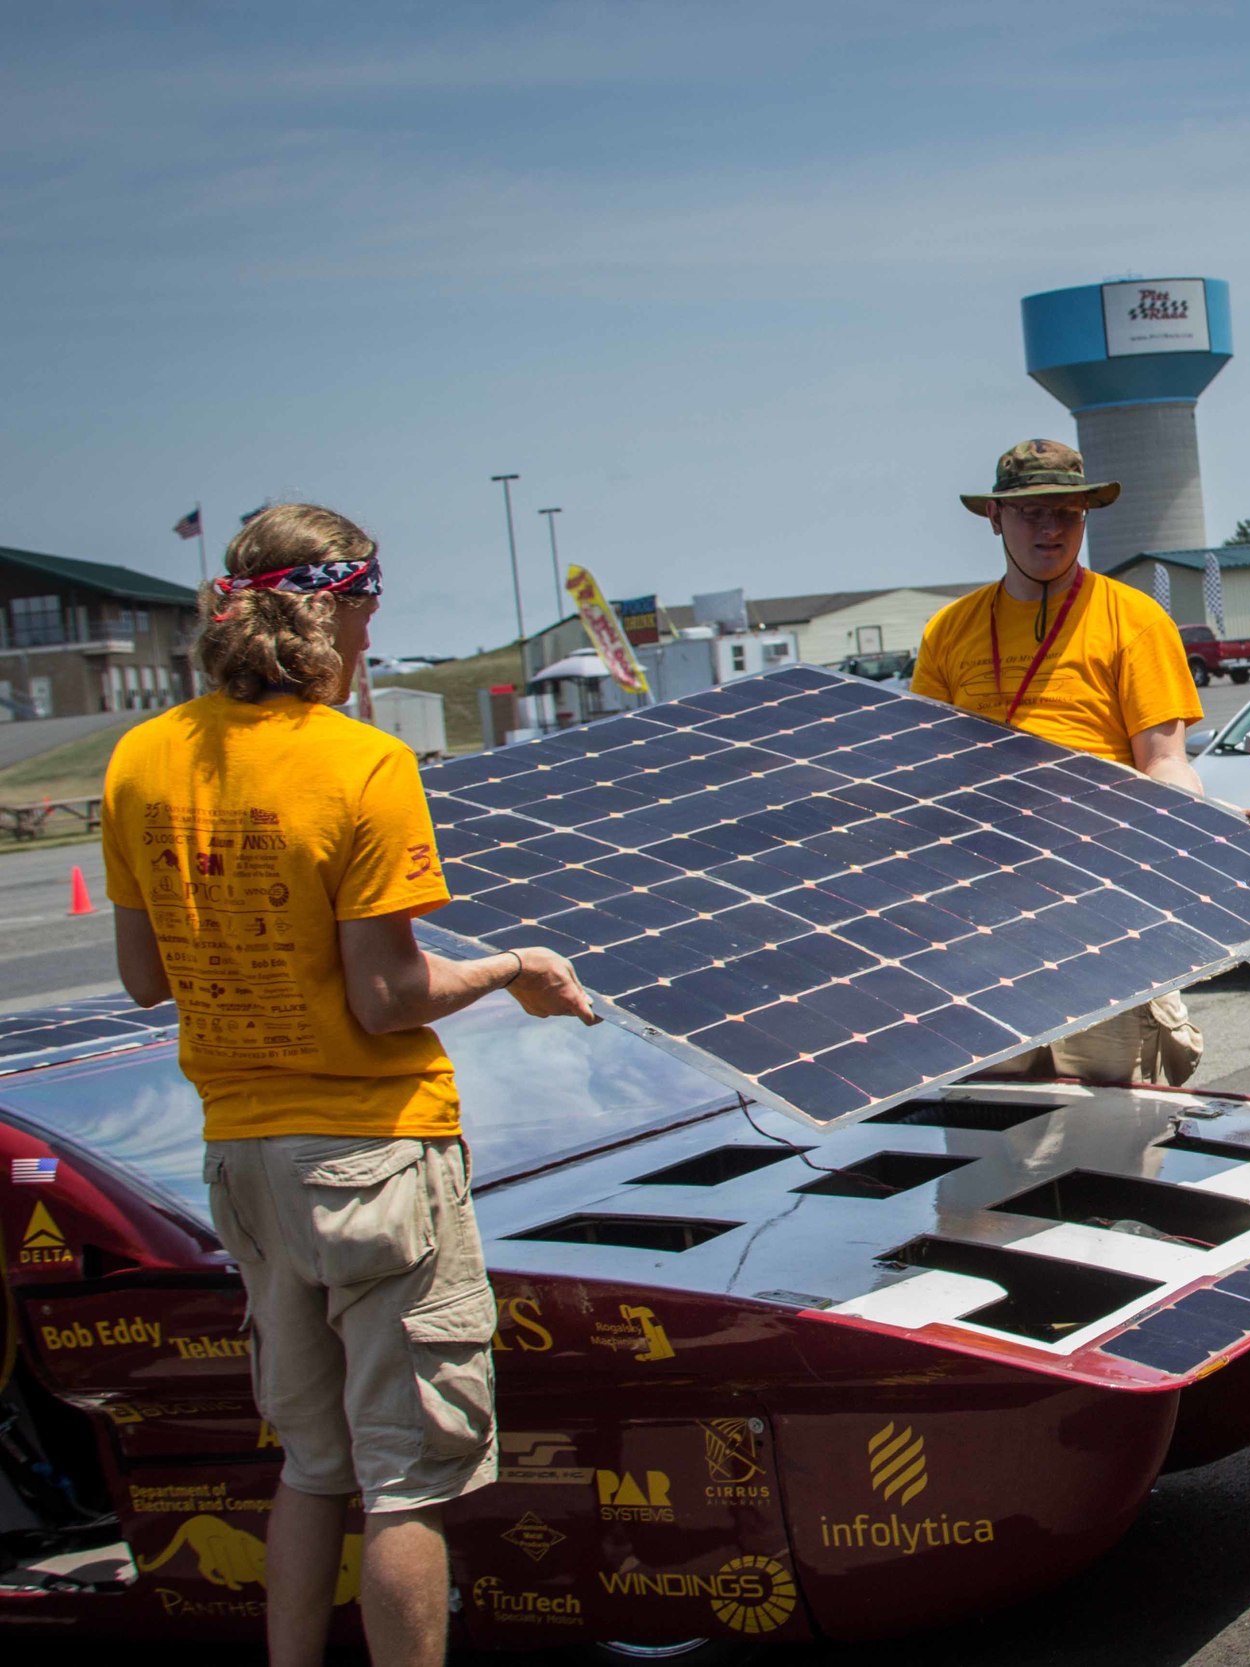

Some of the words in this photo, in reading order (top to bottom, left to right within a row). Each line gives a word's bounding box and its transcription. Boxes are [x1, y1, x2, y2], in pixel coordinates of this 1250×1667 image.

[242, 834, 288, 851] ANSYS
[19, 1248, 74, 1264] DELTA
[41, 1322, 94, 1351] Bob
[95, 1316, 161, 1348] Eddy
[129, 1484, 210, 1499] Department
[212, 1482, 226, 1497] of
[597, 1469, 673, 1506] PAR
[705, 1486, 771, 1498] CIRRUS
[132, 1497, 196, 1512] Electrical
[198, 1498, 224, 1511] and
[600, 1506, 674, 1523] SYSTEMS
[820, 1514, 995, 1556] infolytica
[598, 1570, 765, 1599] WINDINGS
[488, 1589, 582, 1614] TruTech
